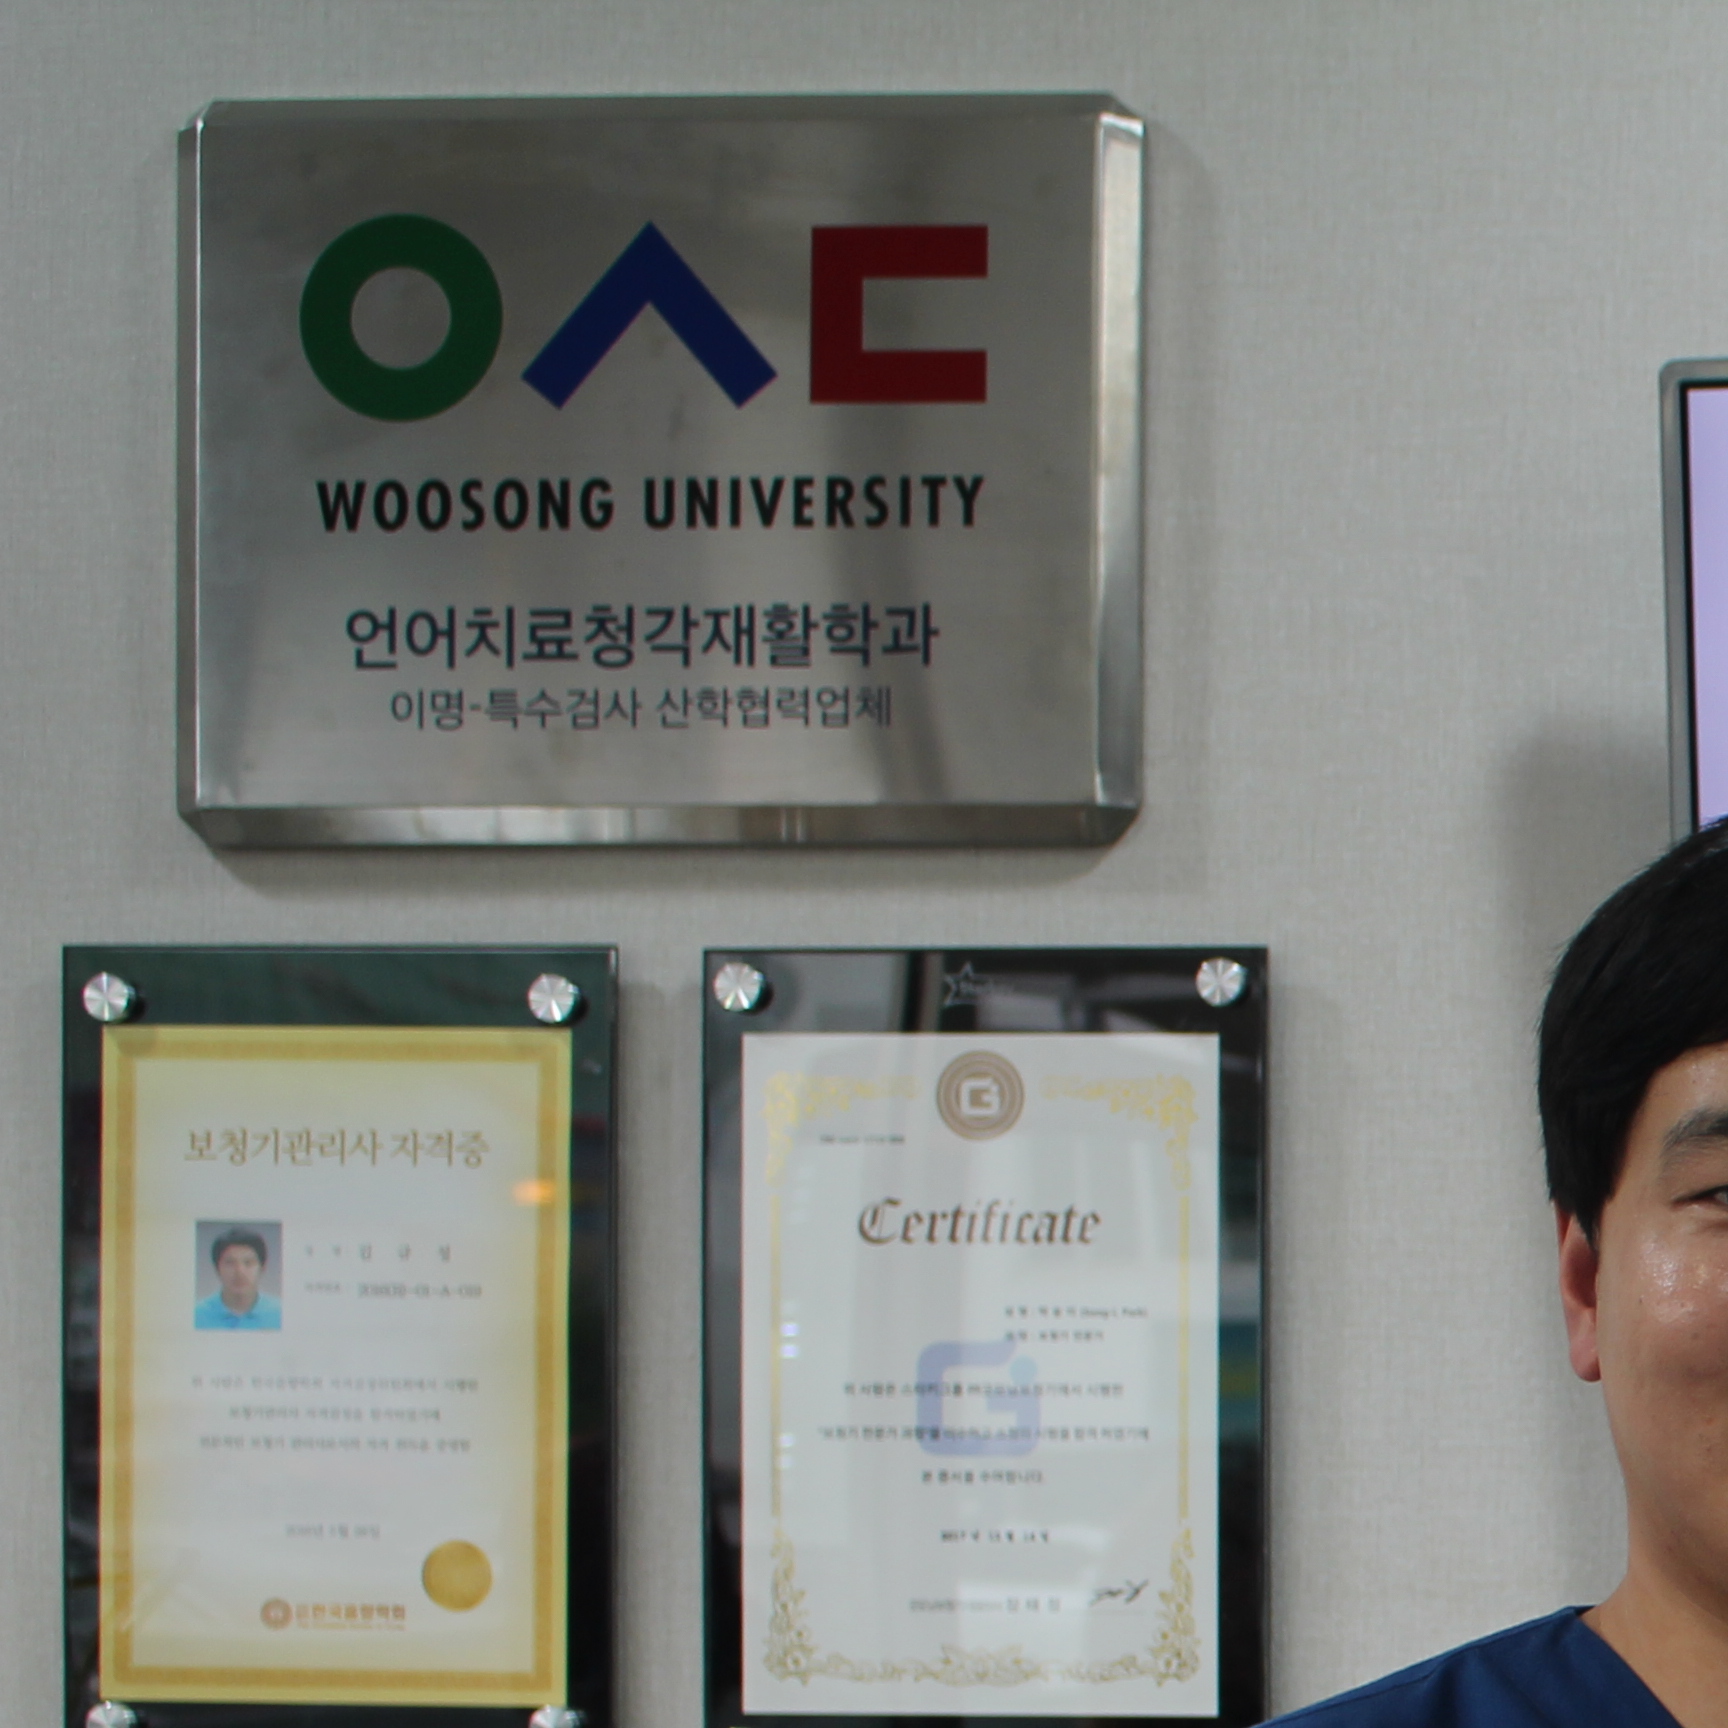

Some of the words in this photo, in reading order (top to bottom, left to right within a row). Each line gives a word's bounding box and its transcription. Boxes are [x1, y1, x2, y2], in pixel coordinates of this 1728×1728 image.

[316, 478, 616, 534] WOOSONG
[643, 474, 987, 531] UNIVERSITY
[344, 599, 939, 673] 언어치료청각재활학과
[389, 685, 642, 732] 이명-특수검사
[655, 683, 893, 731] 산학협력업체
[183, 1128, 383, 1168] 보청기관리사
[389, 1127, 490, 1170] 자격증
[858, 1197, 1102, 1246] Certificate
